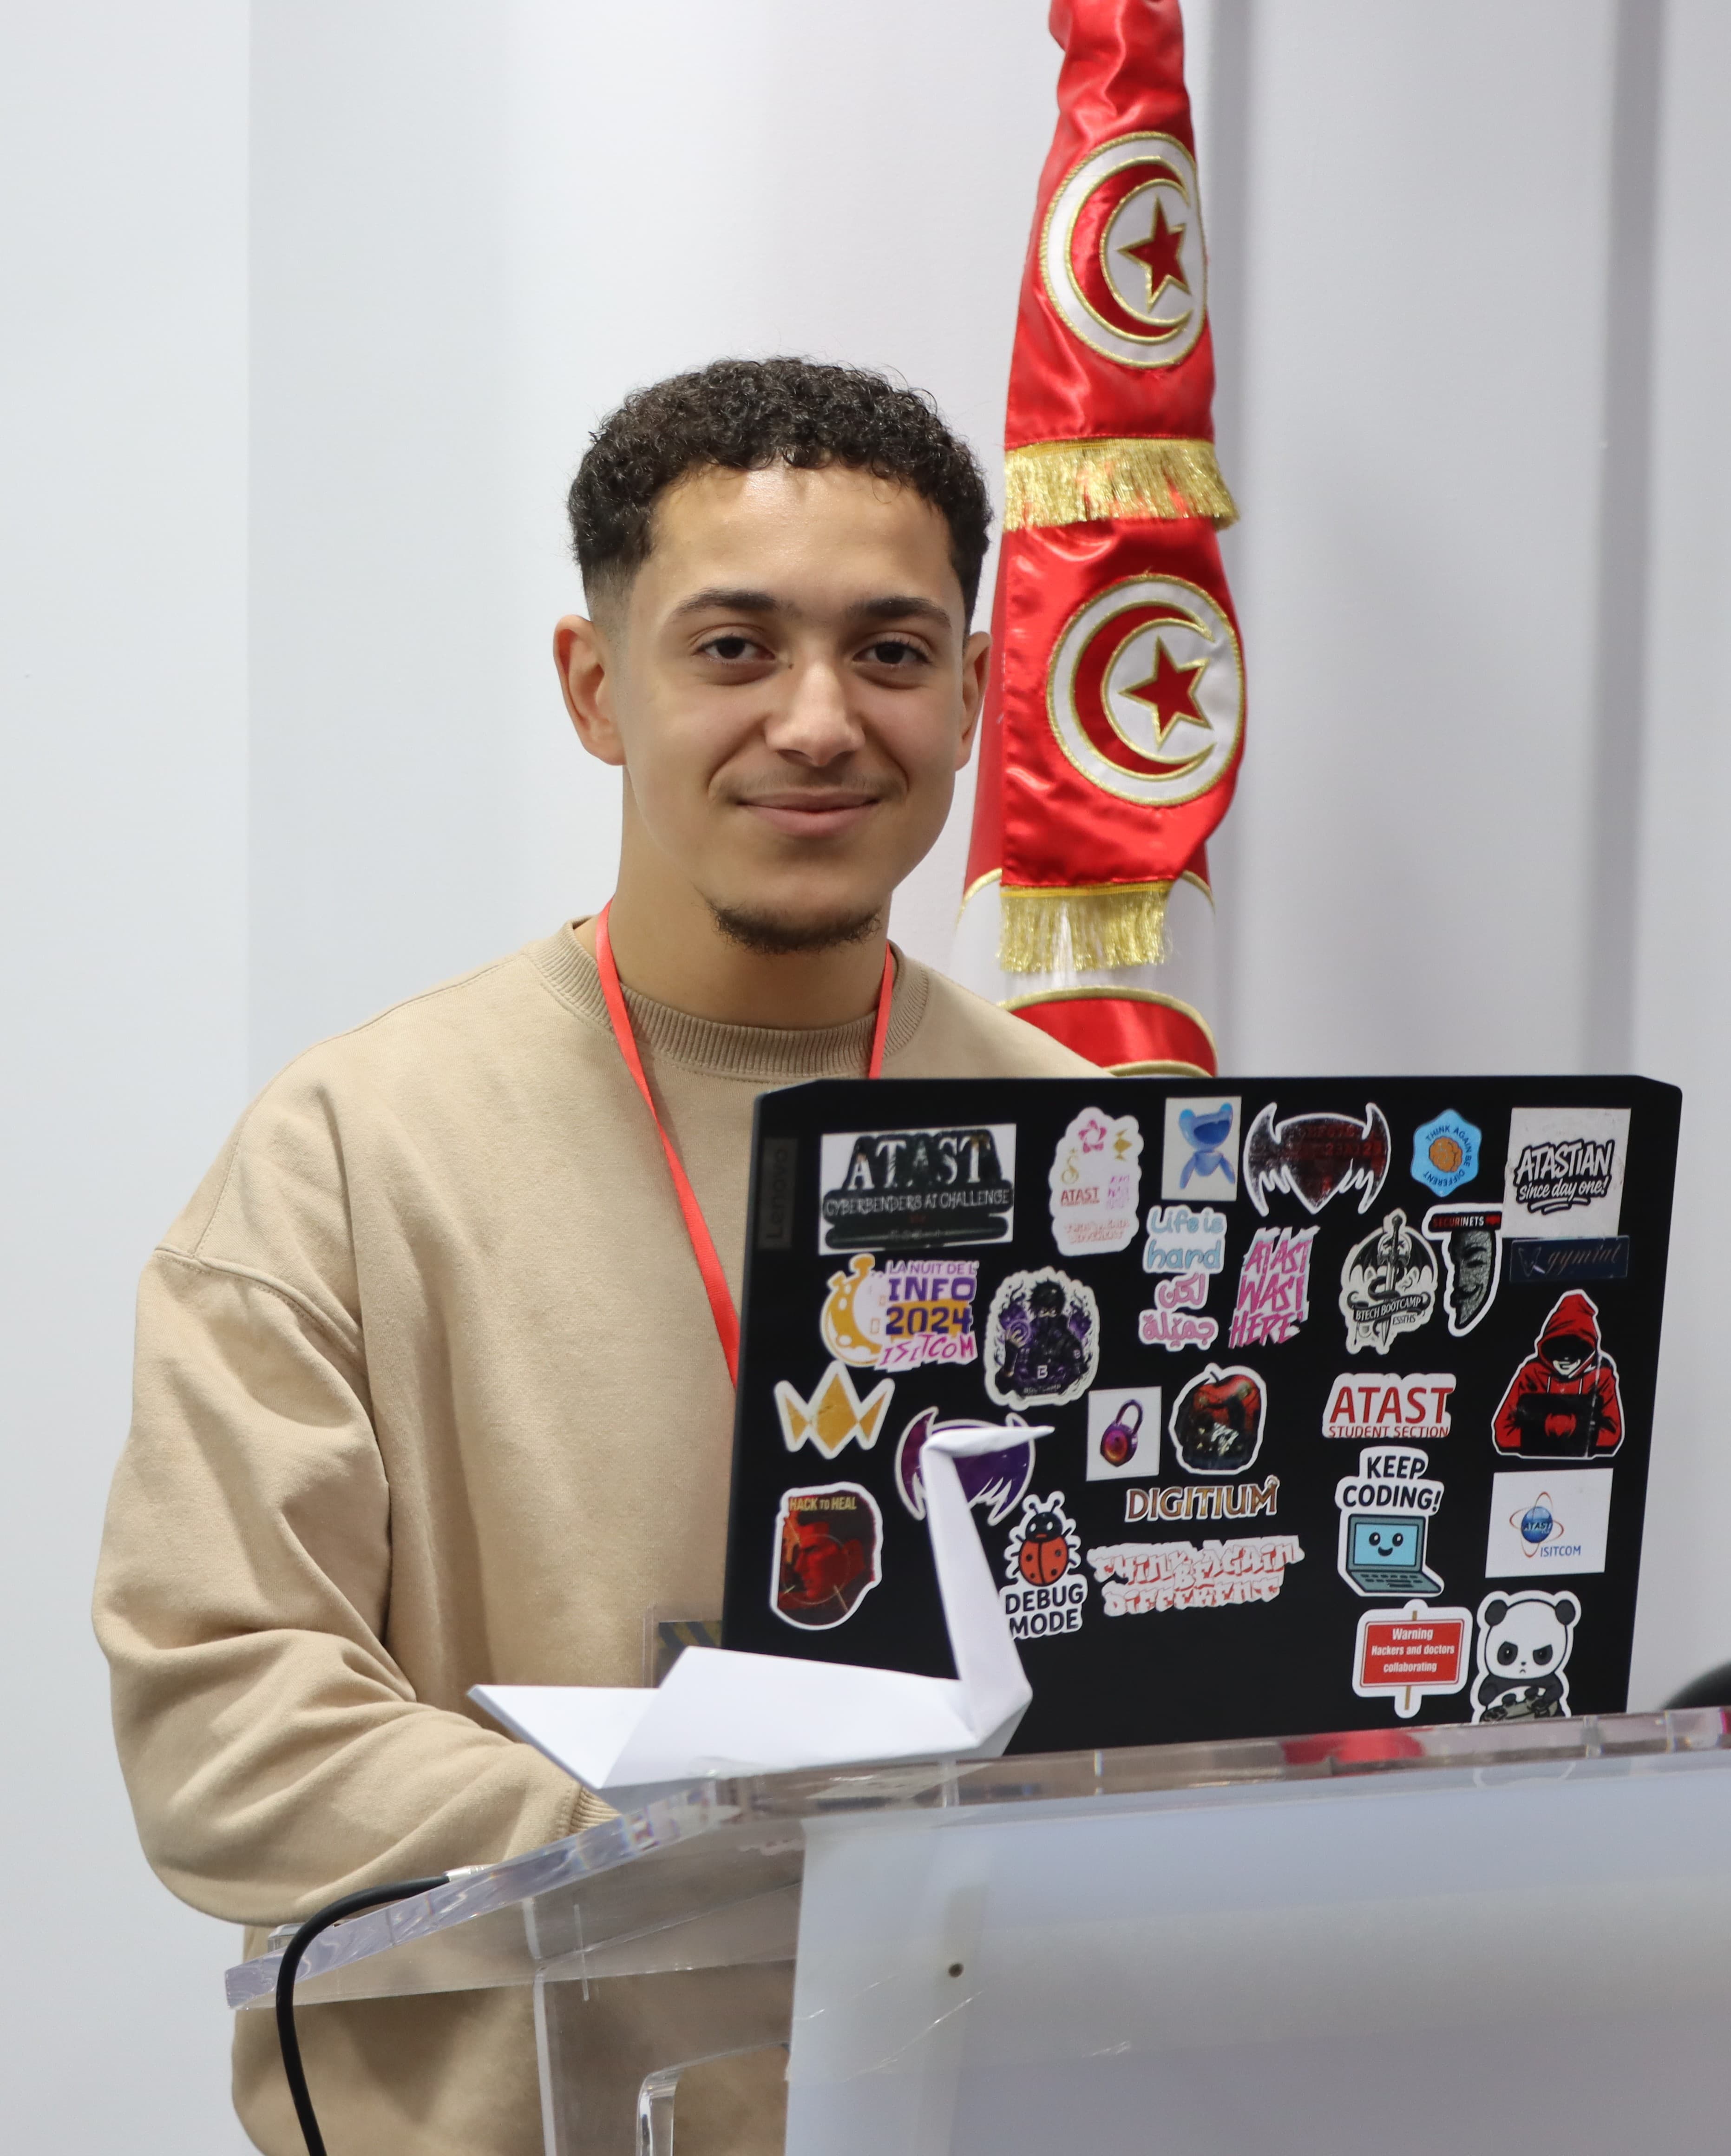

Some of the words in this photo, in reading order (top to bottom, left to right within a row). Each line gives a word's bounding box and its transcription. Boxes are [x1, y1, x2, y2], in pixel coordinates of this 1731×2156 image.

[1426, 1125, 1450, 1141] THINK
[1454, 1126, 1472, 1153] AGAIN
[847, 1136, 991, 1190] ATAST
[1464, 1155, 1472, 1167] BE
[1515, 1140, 1614, 1186] ATASTIAN
[1423, 1169, 1465, 1187] DIFFERENT
[1518, 1184, 1551, 1202] since
[1551, 1178, 1577, 1202] day
[1579, 1178, 1608, 1196] one!
[767, 1148, 788, 1239] Lenovo
[940, 1189, 1010, 1209] CHALLENGE
[1151, 1209, 1199, 1233] Life
[1203, 1210, 1224, 1233] is
[1433, 1216, 1484, 1227] SECURINETS
[1147, 1239, 1220, 1269] hard
[1245, 1239, 1313, 1275] ATAST
[889, 1263, 906, 1274] LA
[910, 1262, 942, 1274] NUIT
[947, 1262, 965, 1275] DE
[889, 1276, 975, 1301] INFO
[1158, 1272, 1206, 1309] لكن
[886, 1307, 972, 1335] 2024
[1355, 1306, 1380, 1321] BTECH
[1381, 1296, 1421, 1316] BOOTCAMP
[1393, 1314, 1416, 1325] ESSTHS
[880, 1333, 974, 1366] ISITCOM
[1329, 1386, 1454, 1424] ATAST
[1329, 1426, 1390, 1438] STUDENT
[1394, 1426, 1449, 1438] SECTION
[1367, 1455, 1426, 1480] KEEP
[791, 1497, 818, 1510] HACK
[831, 1496, 857, 1510] HEAL
[1127, 1482, 1278, 1520] DIGITIUM
[1343, 1484, 1441, 1512] CODING!
[1540, 1545, 1582, 1557] ISITCOM
[1005, 1583, 1083, 1615] DEBUG
[1009, 1608, 1079, 1637] MODE
[1392, 1628, 1434, 1641] Warning
[1371, 1645, 1404, 1656] Hackers
[1406, 1645, 1422, 1656] and
[1423, 1644, 1455, 1655] doctors
[1383, 1662, 1437, 1673] collaborating
